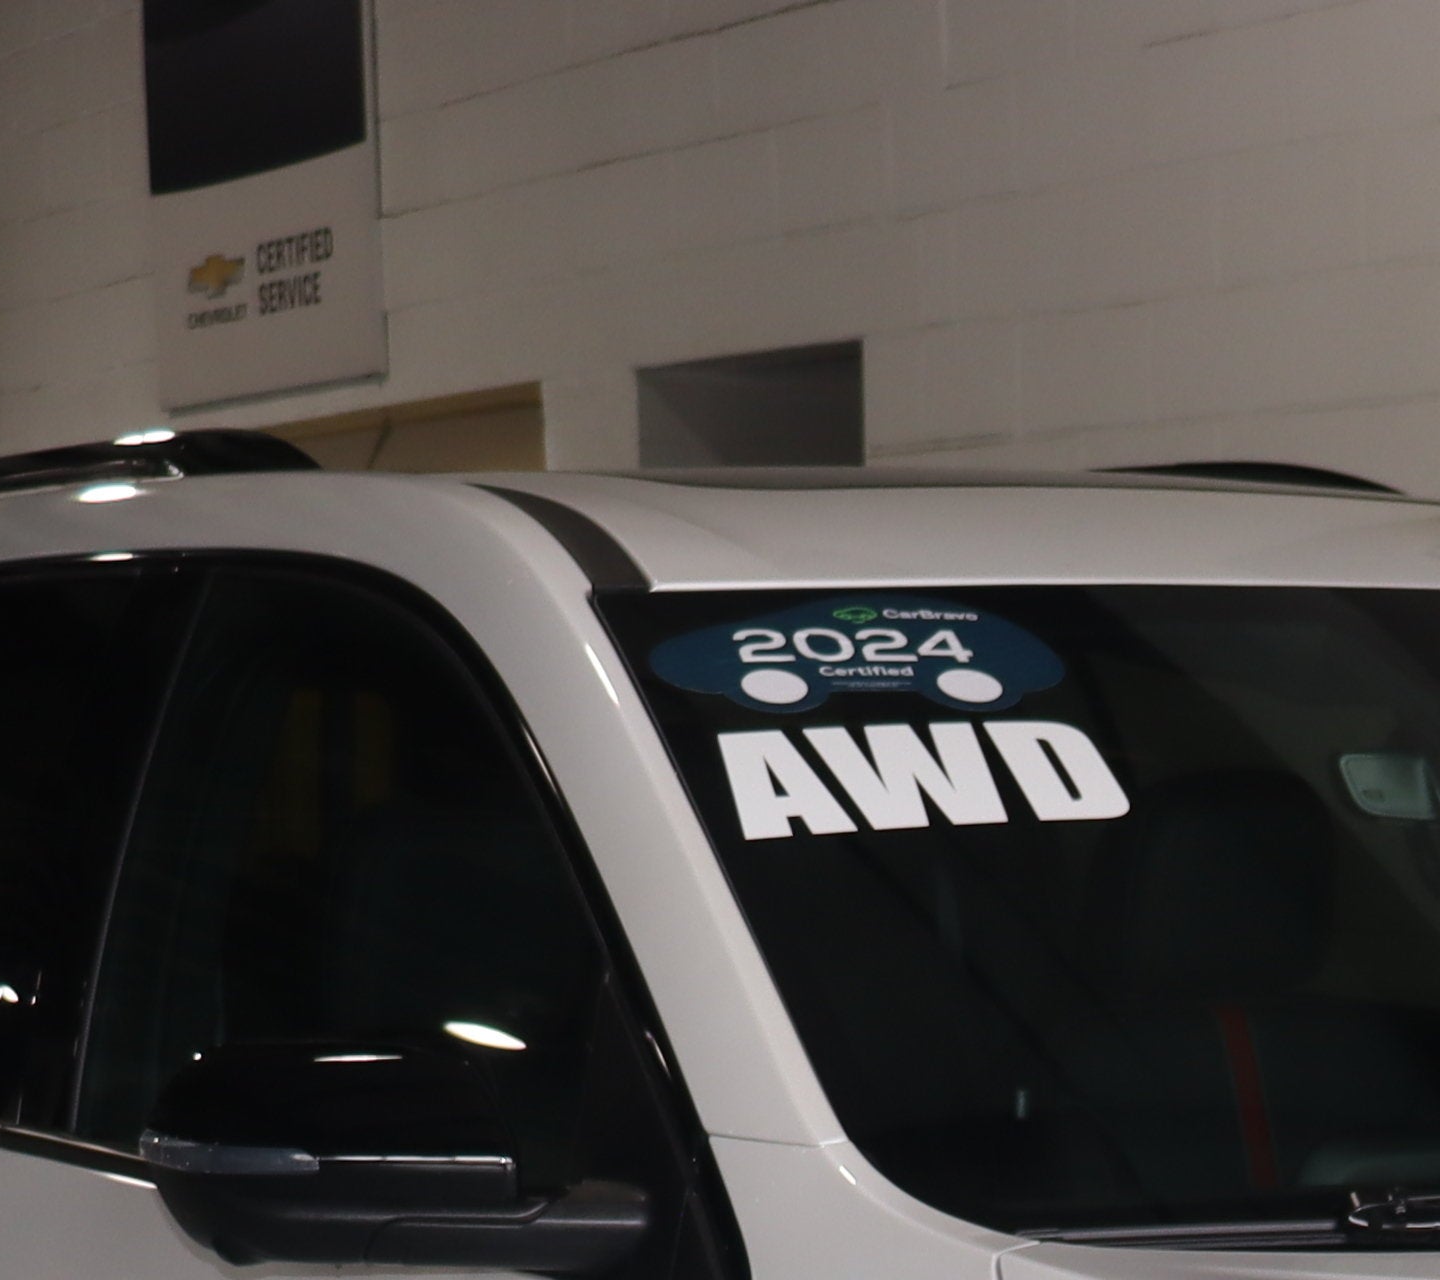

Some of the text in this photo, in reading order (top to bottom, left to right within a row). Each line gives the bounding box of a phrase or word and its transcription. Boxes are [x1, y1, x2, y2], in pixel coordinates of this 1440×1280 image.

[256, 226, 334, 274] CERTIFIED
[258, 271, 322, 316] SERVICE
[881, 608, 979, 622] CarBravo
[732, 627, 974, 663] 2024
[818, 665, 915, 678] Certified
[717, 720, 1131, 841] AWD
